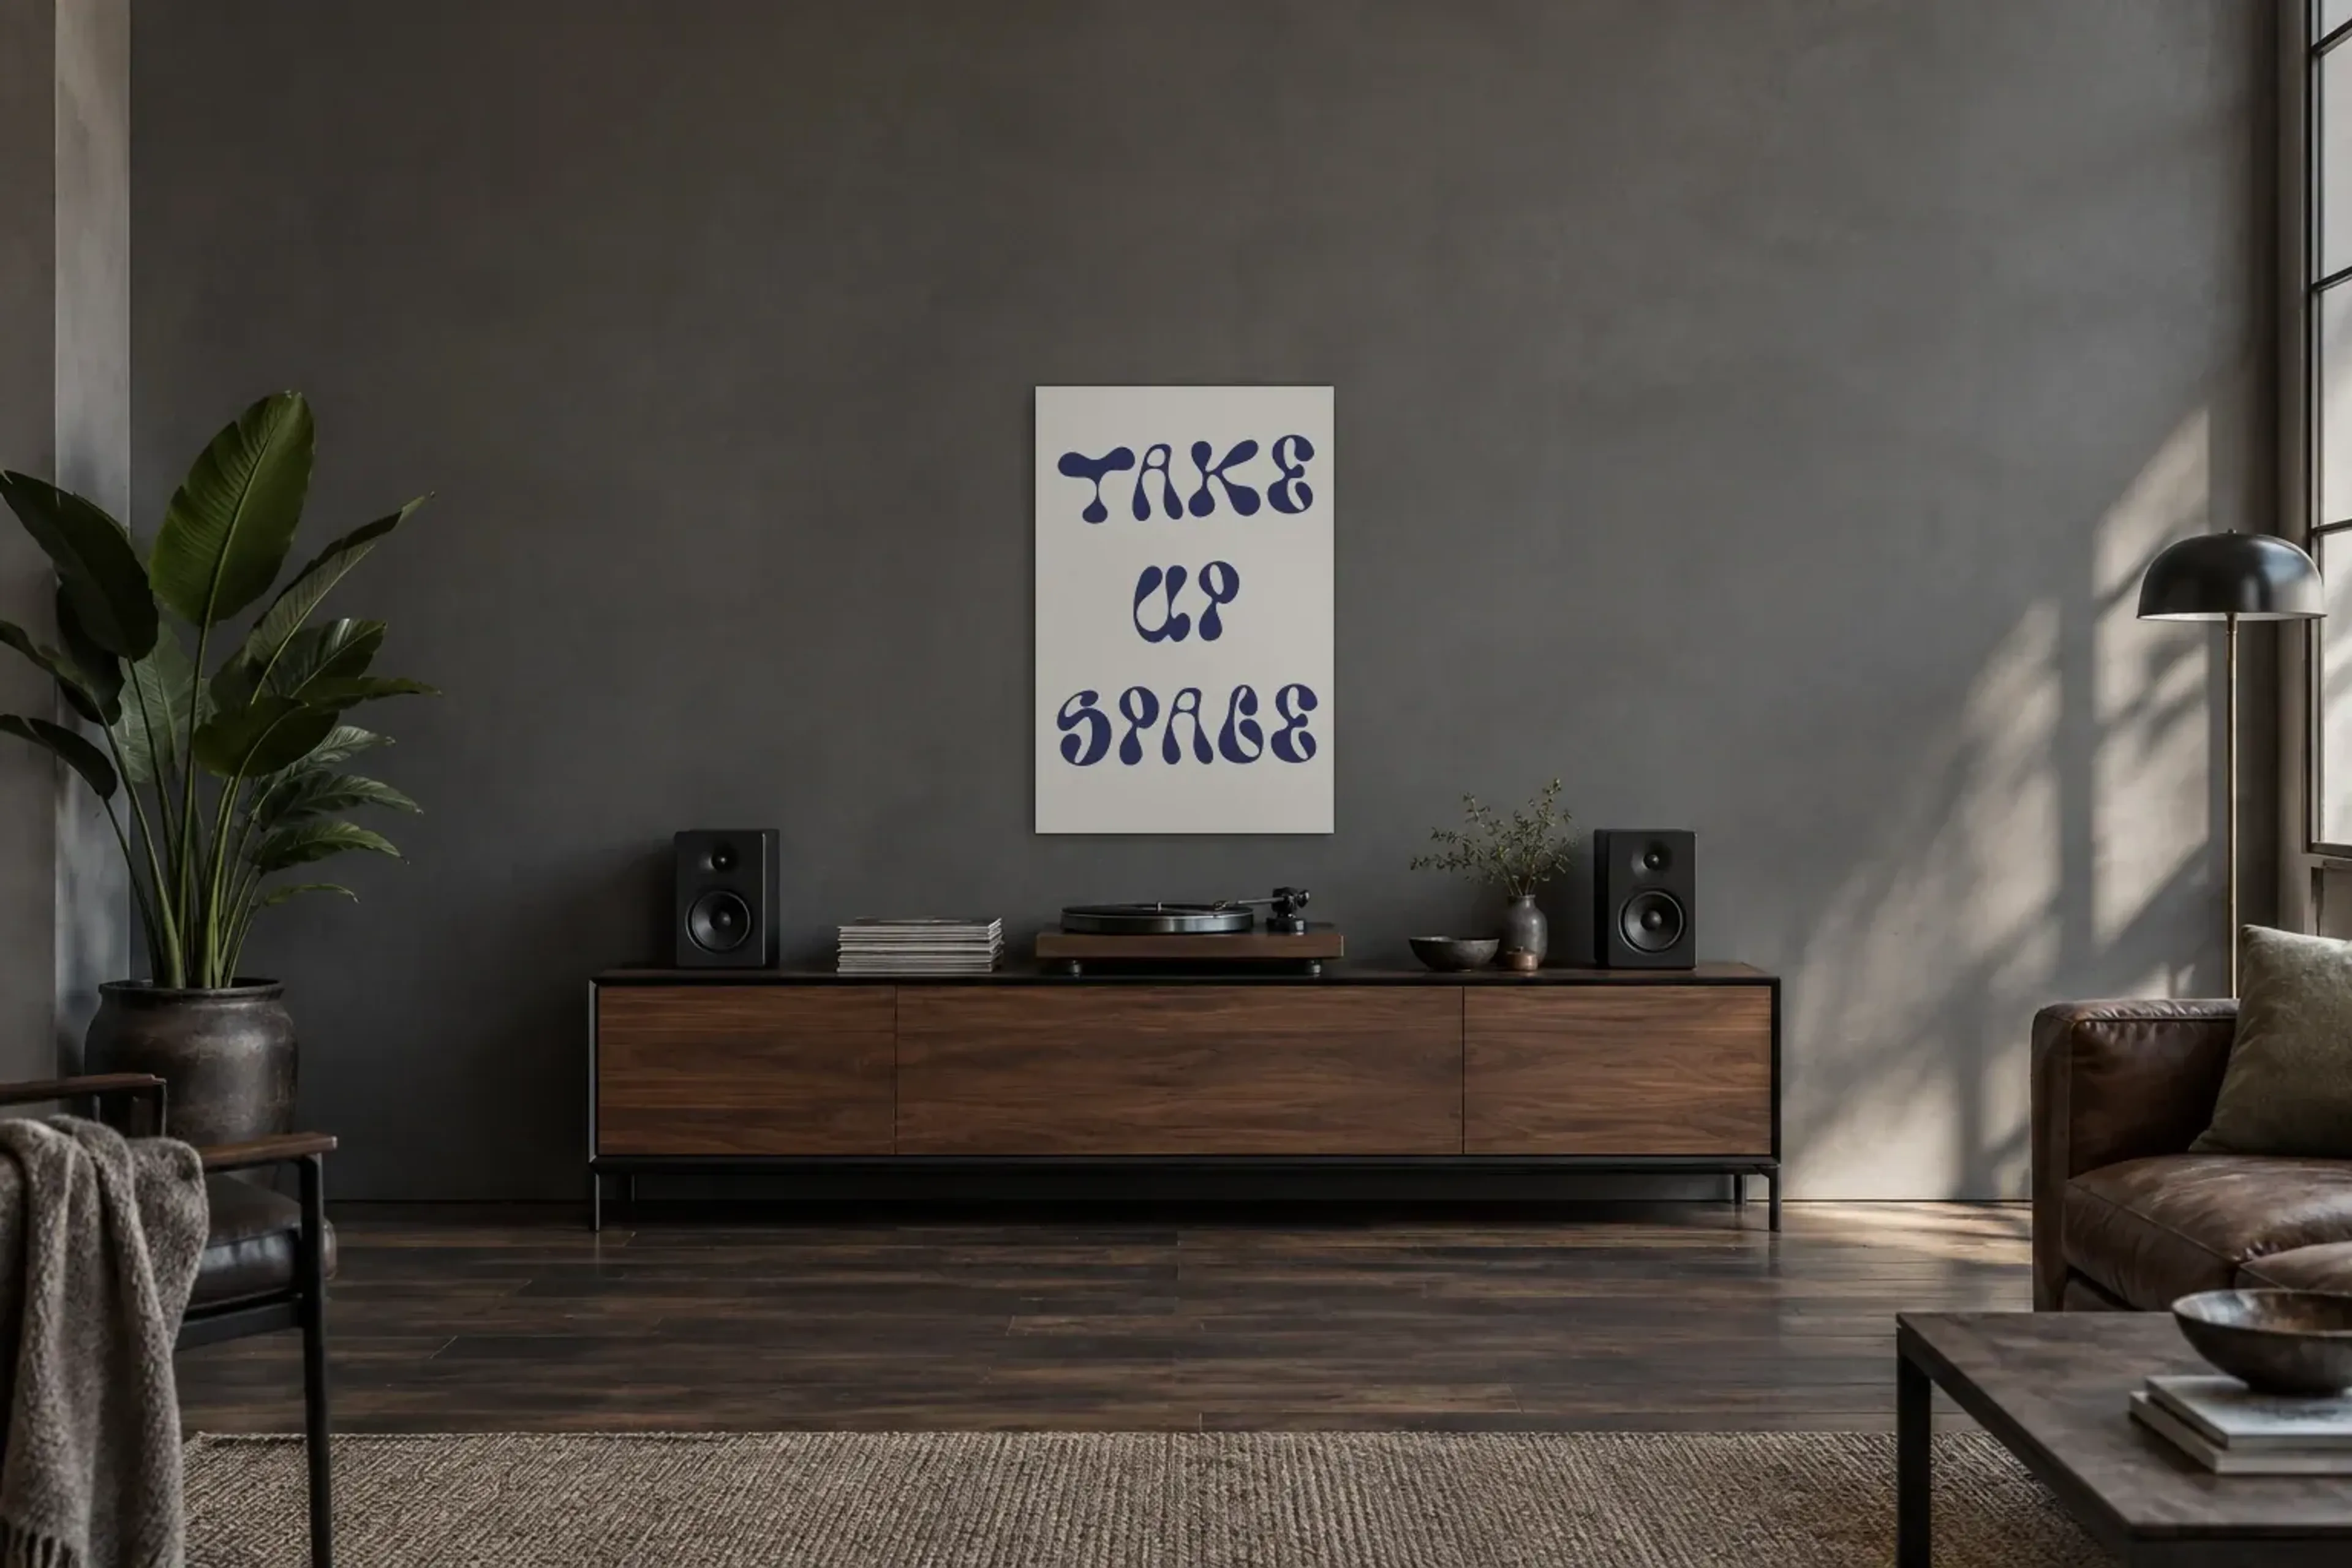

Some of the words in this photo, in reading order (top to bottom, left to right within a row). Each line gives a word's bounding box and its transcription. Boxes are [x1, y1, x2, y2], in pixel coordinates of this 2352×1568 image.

[1058, 434, 1314, 524] TAKE
[1134, 561, 1240, 643] UP
[1057, 684, 1317, 766] SPACE
